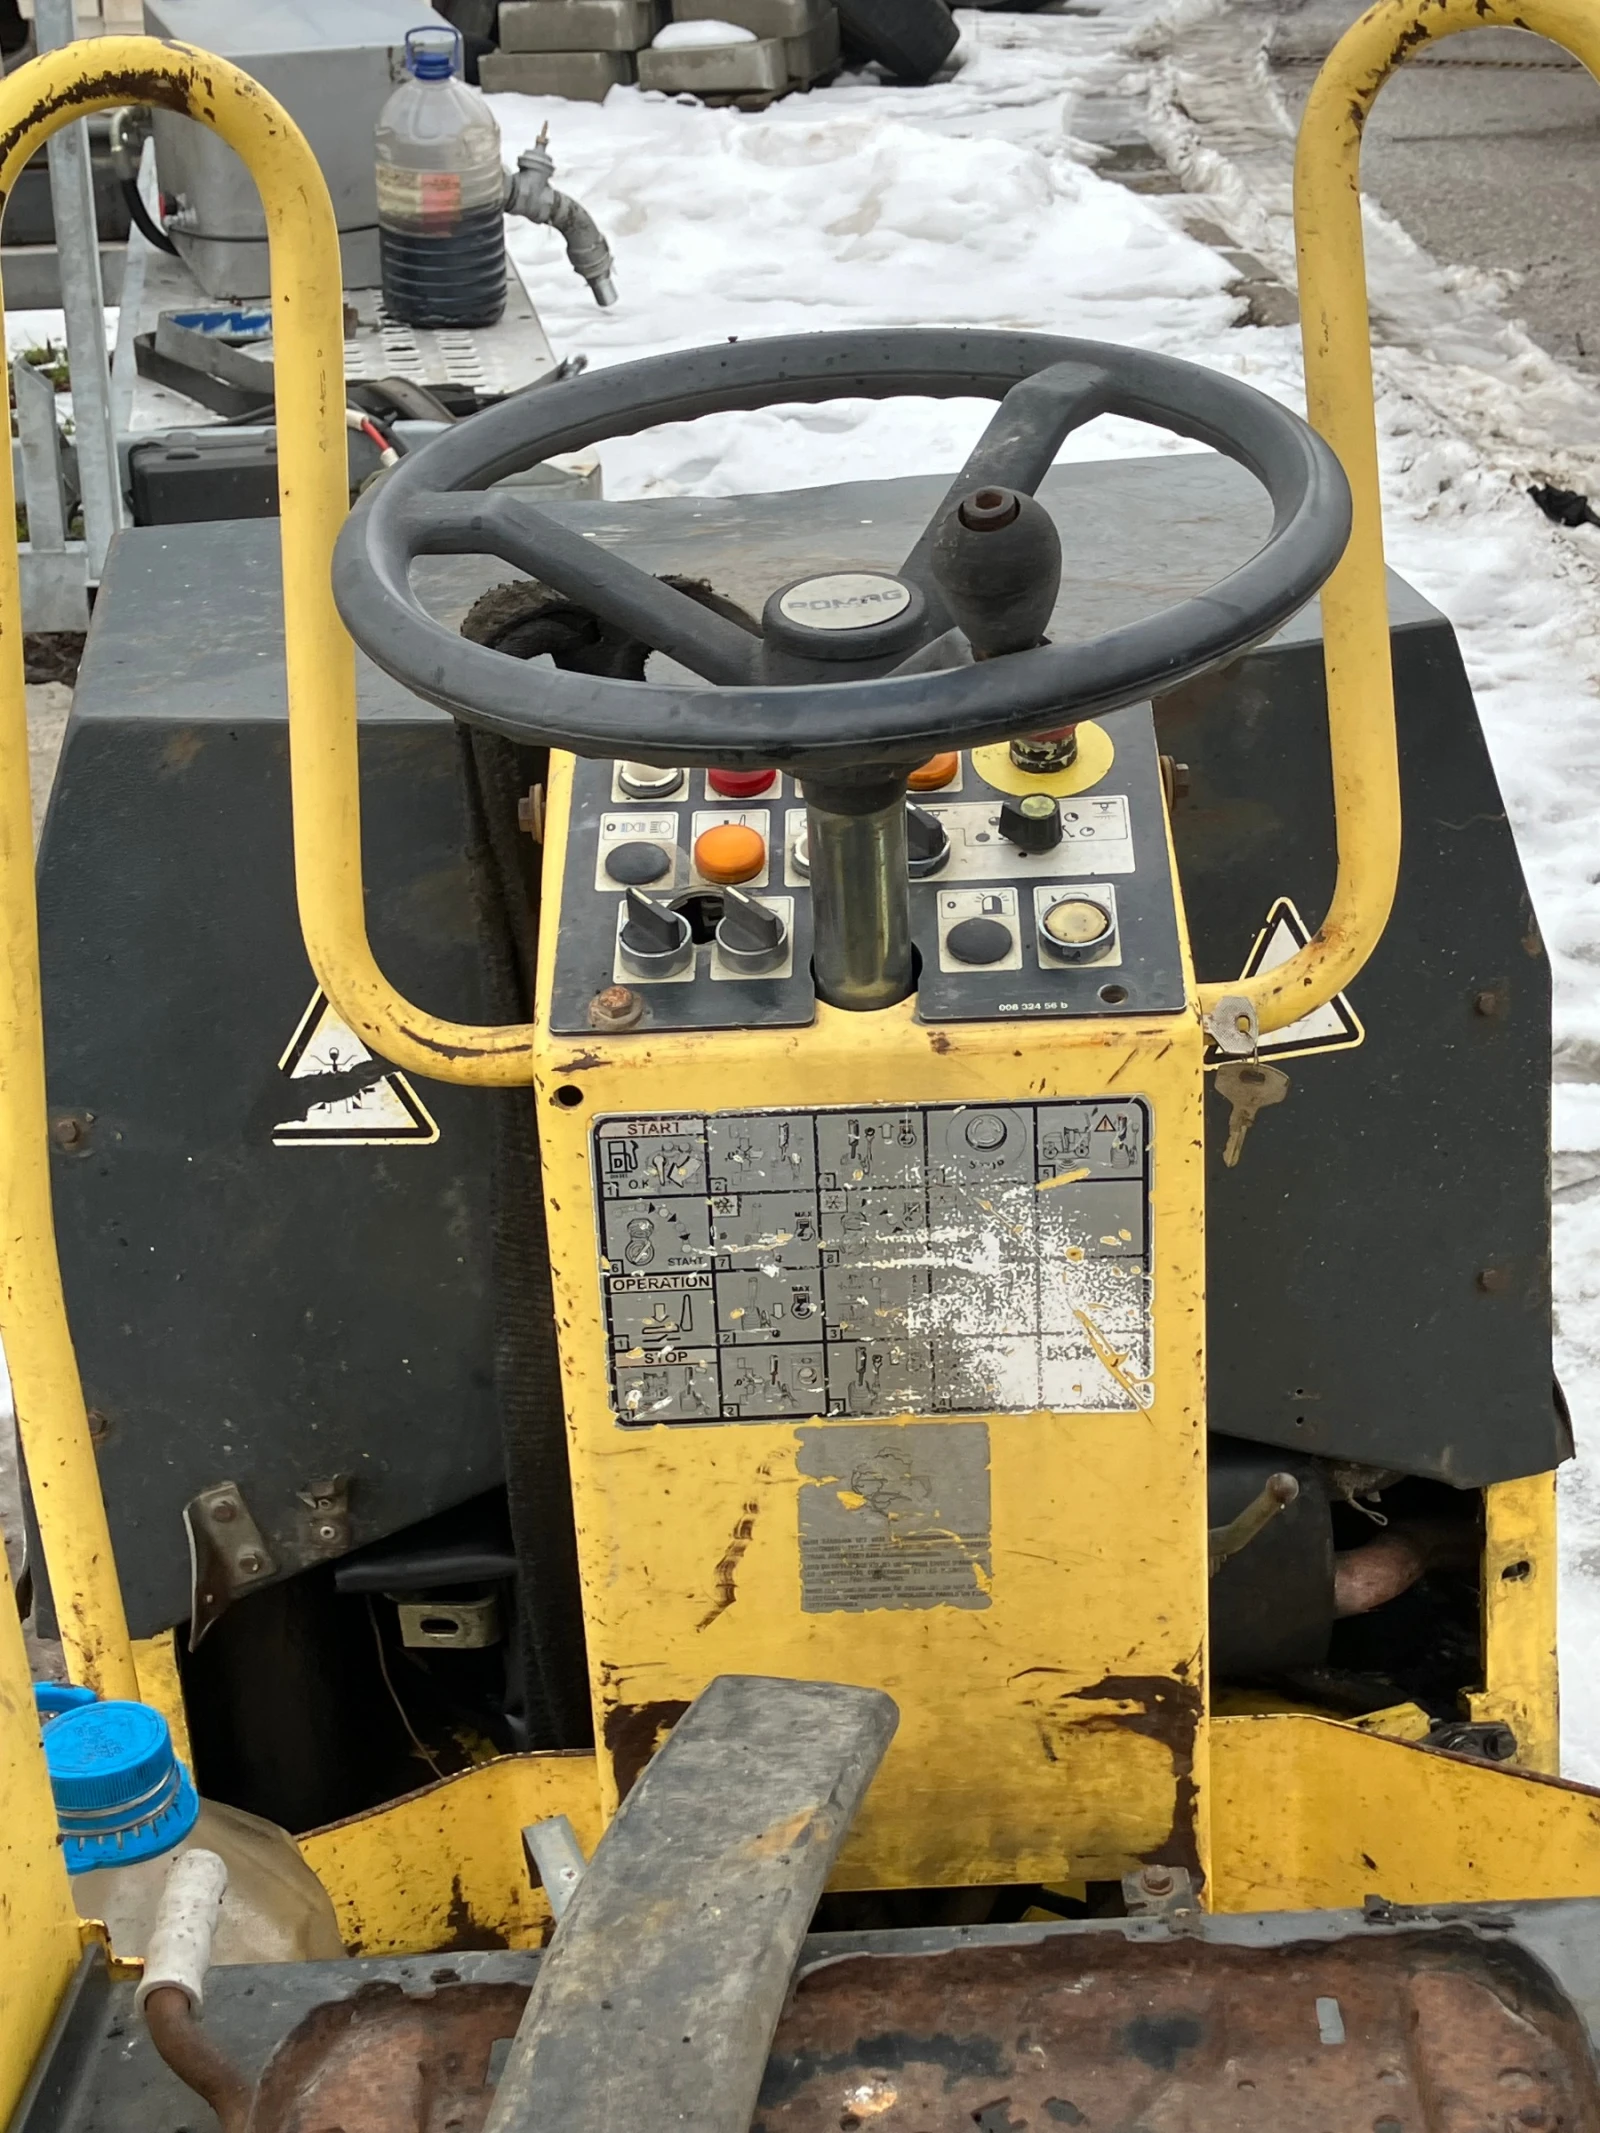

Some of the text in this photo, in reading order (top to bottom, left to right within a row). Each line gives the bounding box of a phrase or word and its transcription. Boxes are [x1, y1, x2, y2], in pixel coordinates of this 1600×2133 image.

[1021, 1002, 1042, 1011] 324
[1044, 1002, 1058, 1010] 56
[627, 1122, 681, 1135] START
[714, 1181, 722, 1191] 2
[667, 1256, 704, 1267] START
[718, 1258, 726, 1268] 7
[611, 1264, 619, 1273] 6
[612, 1275, 711, 1291] OPERATION
[722, 1333, 731, 1343] 2
[830, 1329, 838, 1339] 3
[644, 1351, 688, 1365] STOP
[727, 1406, 735, 1416] 2
